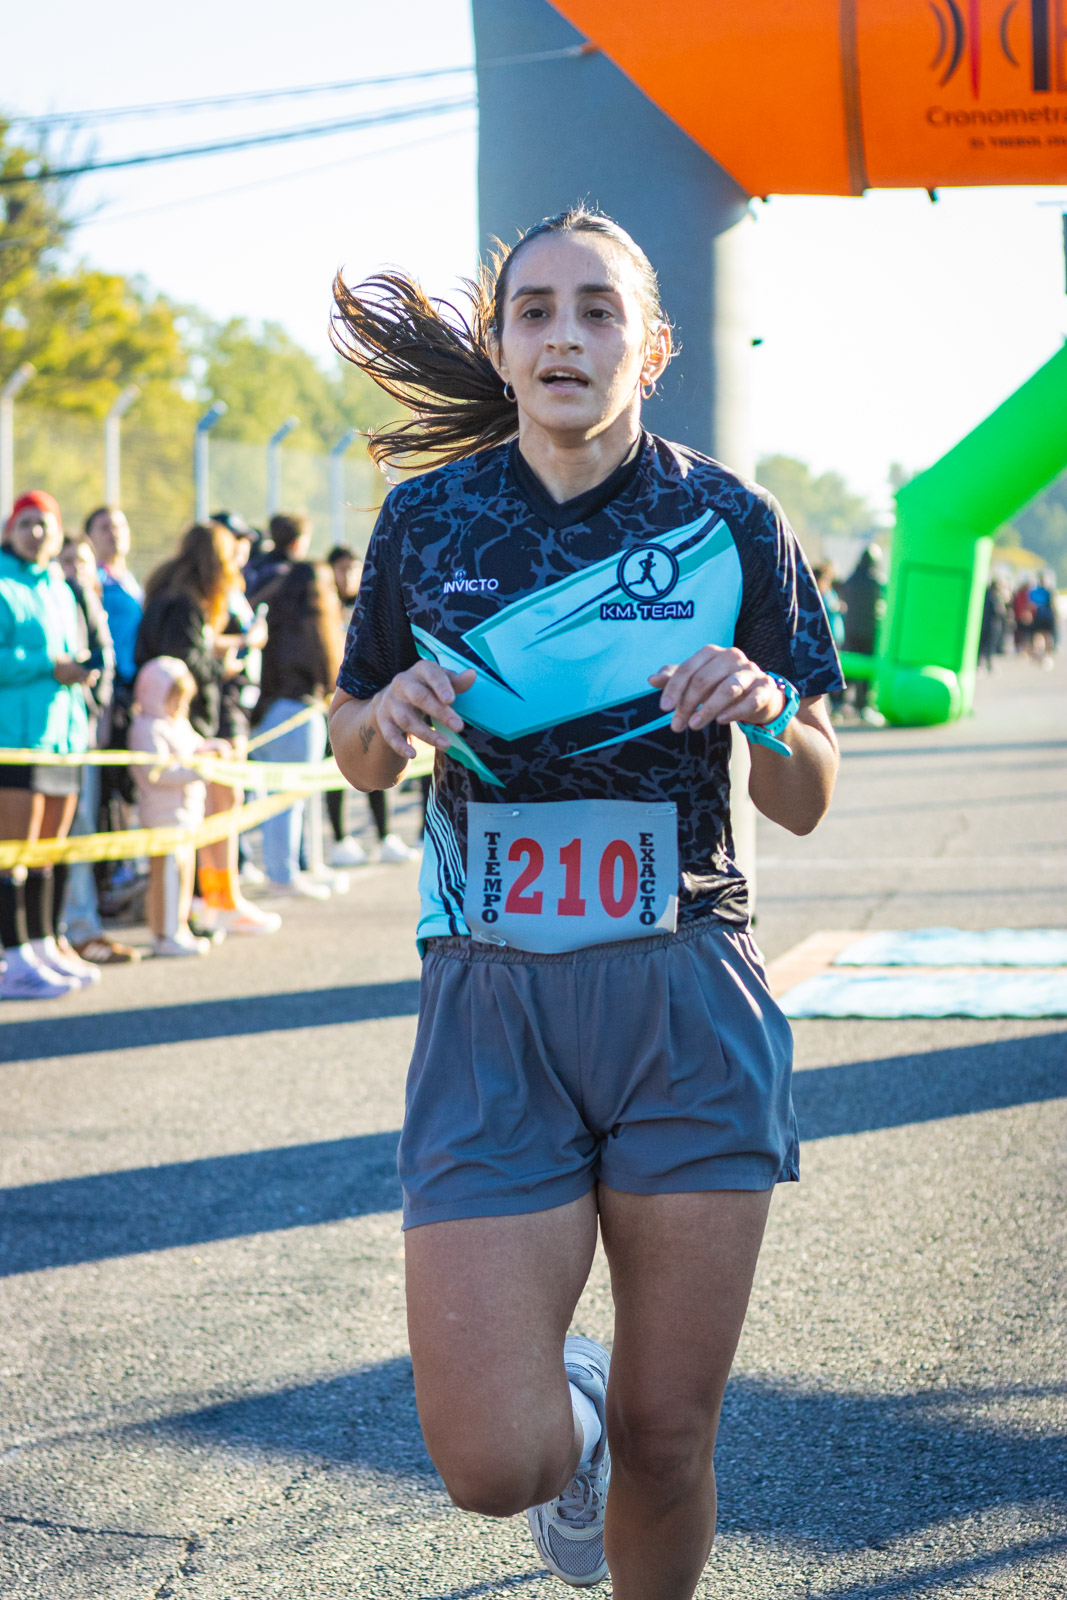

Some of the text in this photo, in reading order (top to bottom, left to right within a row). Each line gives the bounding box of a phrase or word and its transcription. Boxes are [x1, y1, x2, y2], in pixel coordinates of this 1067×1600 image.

[443, 578, 499, 594] INVICTO
[640, 602, 694, 618] TEAM
[481, 831, 502, 924] TIEMPO
[504, 837, 639, 919] 210
[638, 832, 657, 926] EXACTO
